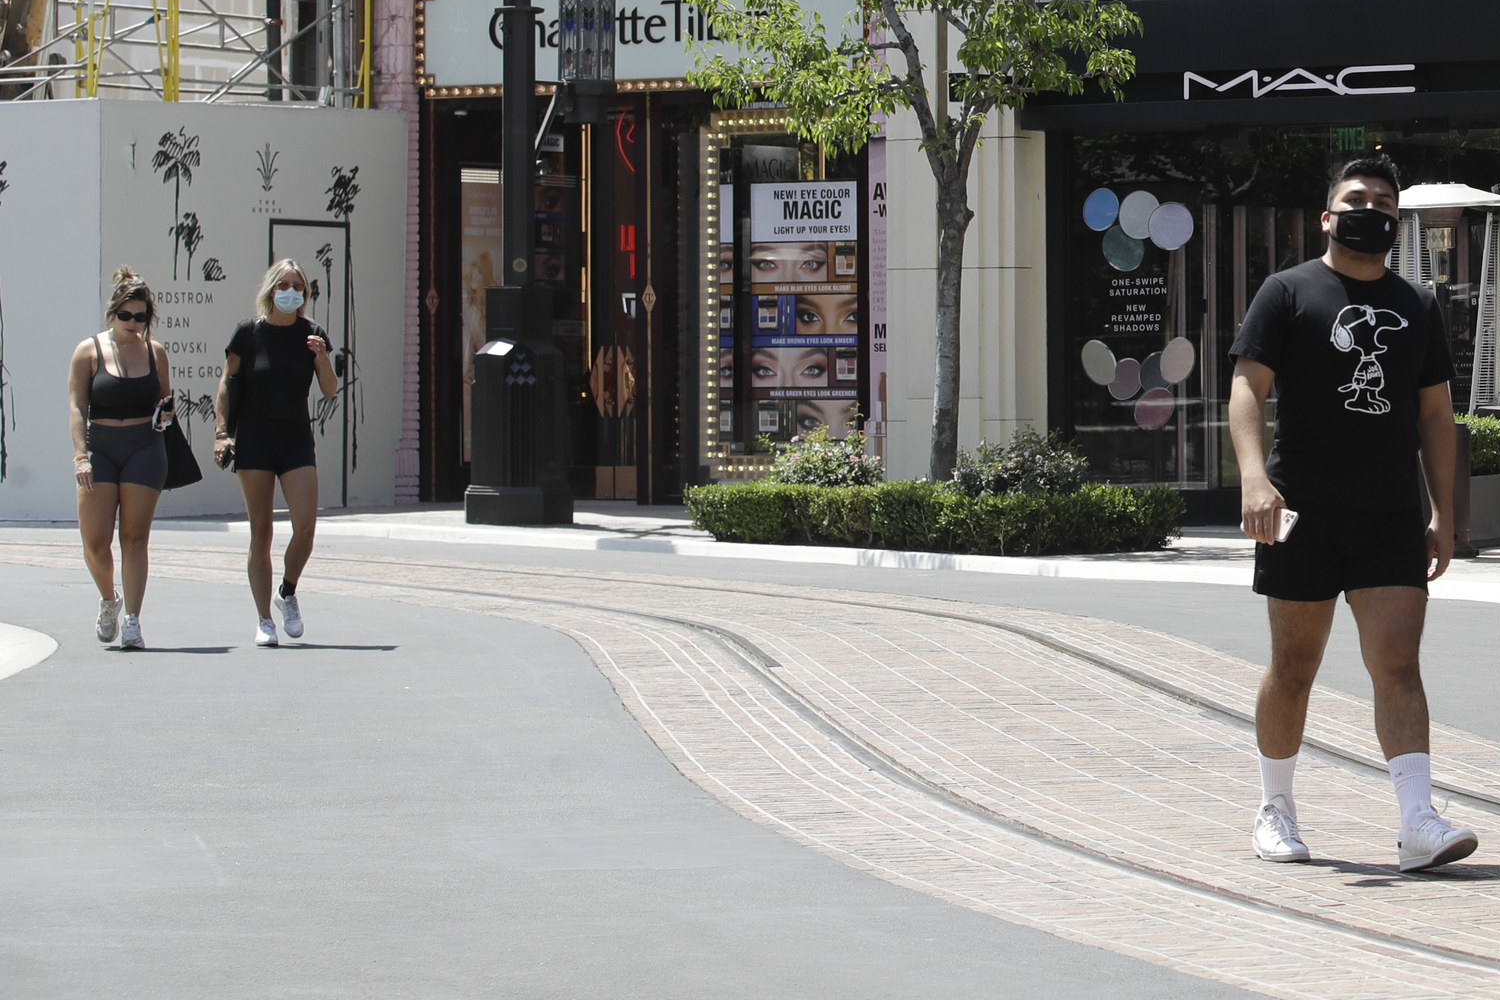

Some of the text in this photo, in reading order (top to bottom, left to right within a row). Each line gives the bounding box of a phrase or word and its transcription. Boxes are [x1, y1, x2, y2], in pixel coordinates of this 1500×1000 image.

[774, 188, 850, 200] NEW! EYE COLOR
[783, 200, 842, 220] MAGIC
[774, 225, 851, 235] LIGHT UP YOUR EYES!
[1111, 277, 1164, 287] ONE-SWIPE
[151, 291, 214, 304] ORDSTROM
[1109, 287, 1167, 297] SATURATION
[1126, 304, 1147, 312] NEW
[151, 316, 190, 329] Y-BAN
[1111, 313, 1161, 322] REVAMPED
[1113, 324, 1160, 332] SHADOWS
[164, 341, 207, 354] ROVSKI
[171, 366, 223, 379] THE GRO
